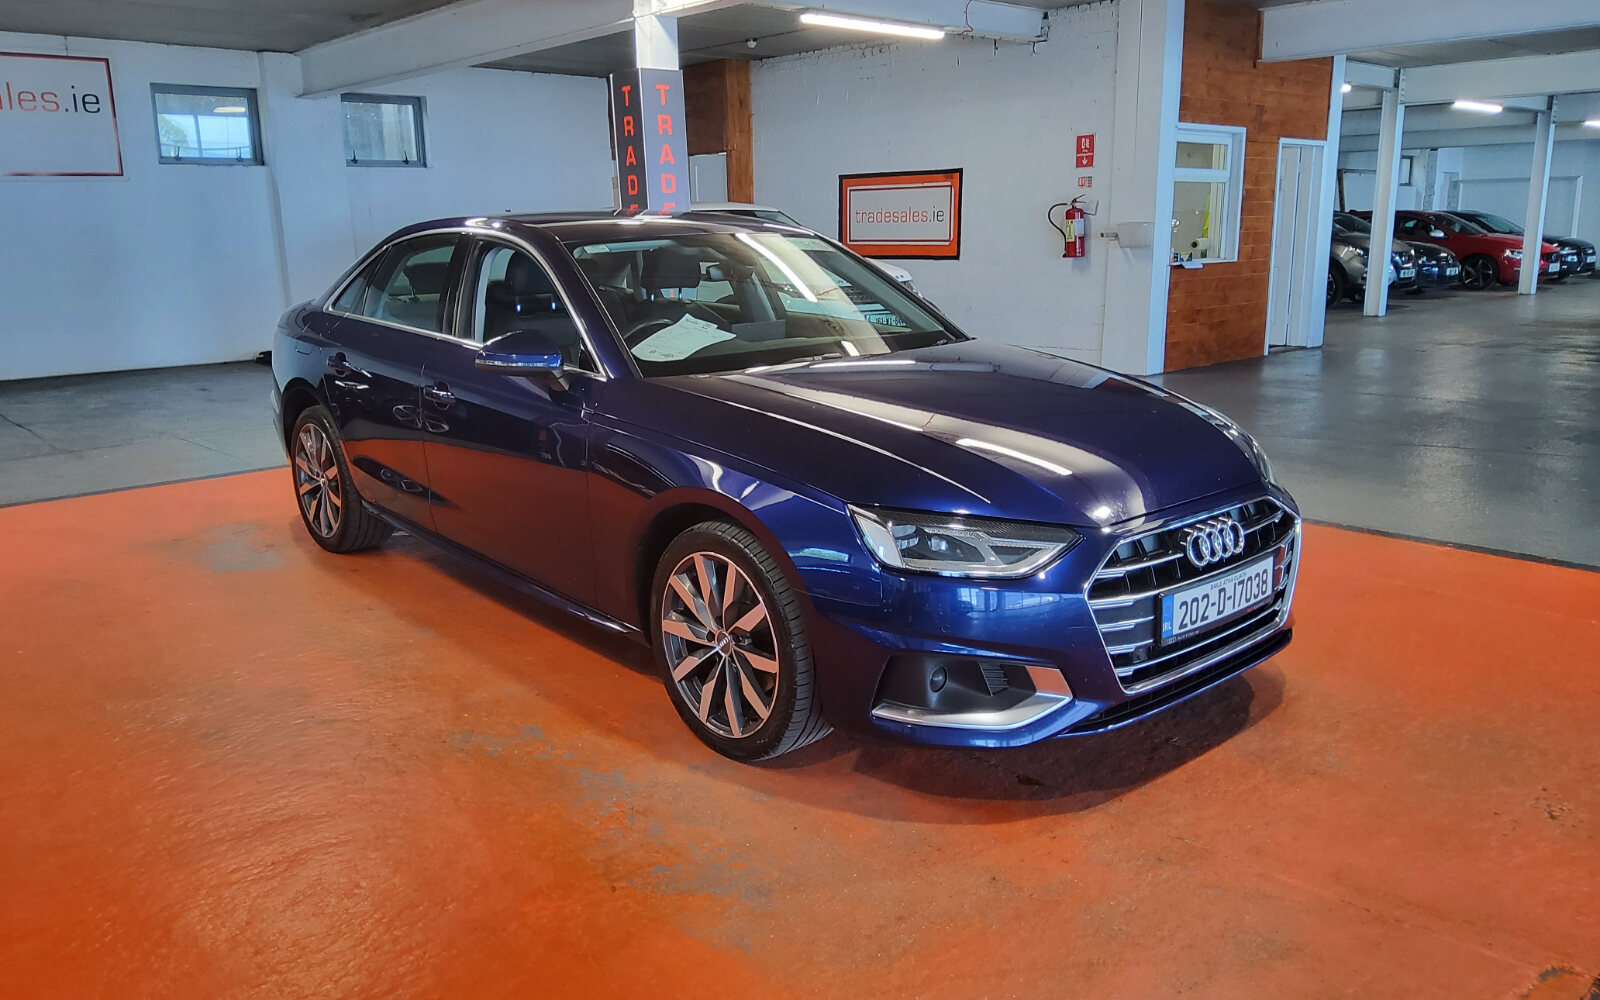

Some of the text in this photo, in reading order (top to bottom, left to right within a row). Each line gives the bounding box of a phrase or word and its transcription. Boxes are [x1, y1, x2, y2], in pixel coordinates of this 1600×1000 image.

[0, 82, 101, 113] les.ie
[855, 206, 945, 224] tradesales.ie
[1178, 568, 1268, 631] 202-D-17038
[1162, 621, 1172, 633] IRL
